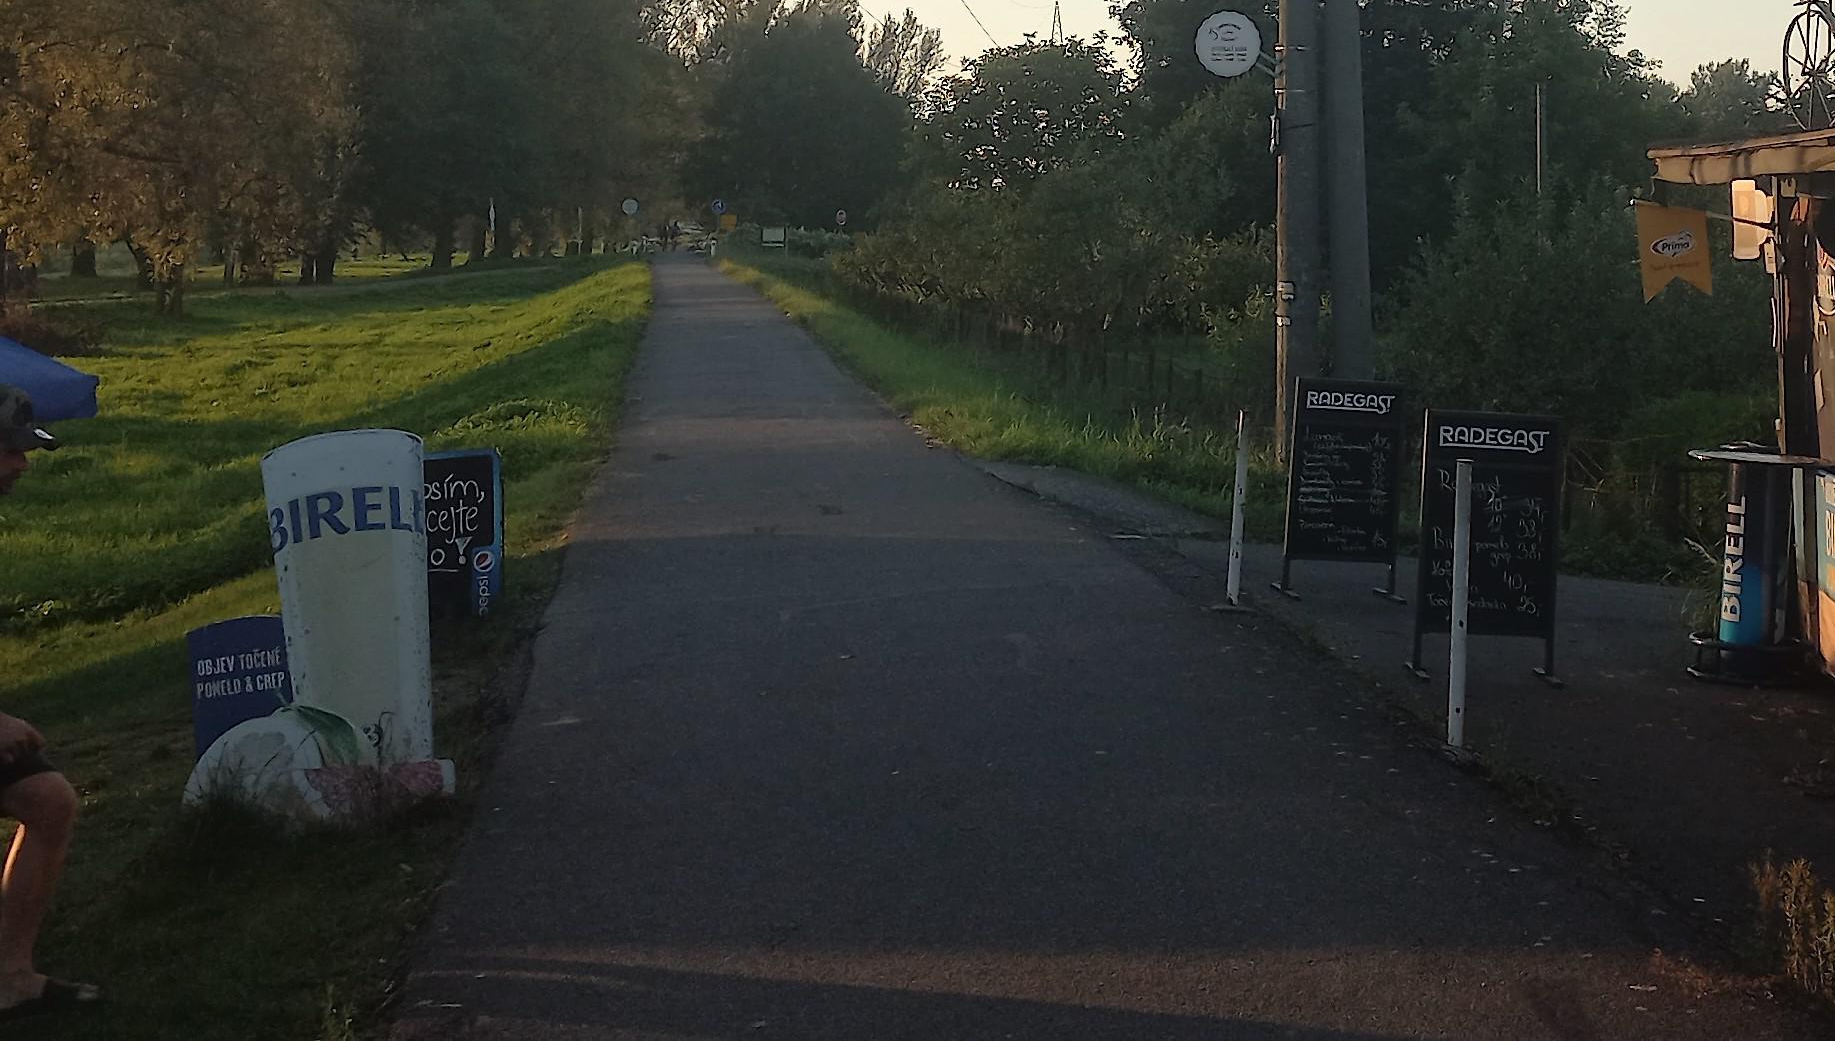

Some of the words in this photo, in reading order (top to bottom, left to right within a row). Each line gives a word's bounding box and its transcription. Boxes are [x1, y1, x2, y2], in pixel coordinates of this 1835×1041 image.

[1305, 390, 1396, 415] RADEGAST
[1439, 425, 1550, 454] RADEGAST
[424, 473, 485, 504] osím,
[426, 499, 479, 544] cejte
[1719, 494, 1747, 623] BIRELL
[197, 655, 235, 677] OBJEV
[245, 674, 255, 694] &
